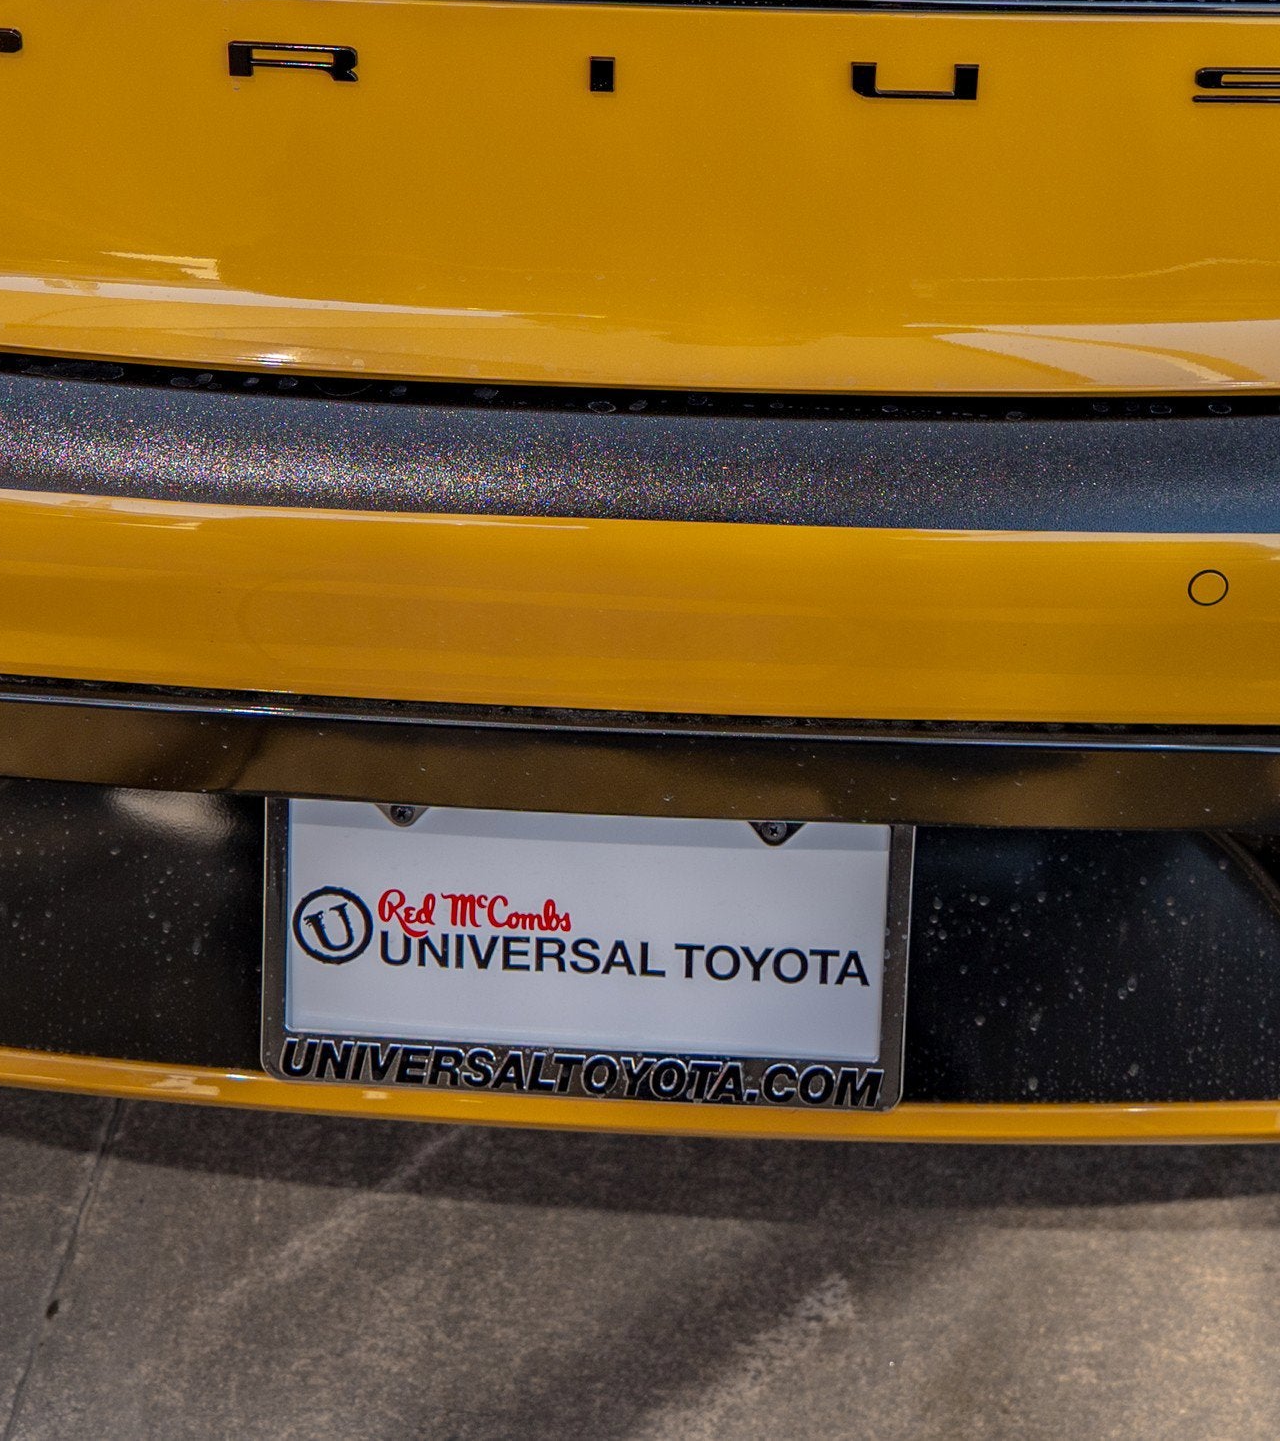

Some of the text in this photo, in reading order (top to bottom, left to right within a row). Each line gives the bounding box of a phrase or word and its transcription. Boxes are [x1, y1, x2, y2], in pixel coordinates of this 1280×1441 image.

[378, 888, 572, 938] Red McCombs
[379, 930, 870, 986] UNIVERSAL TOYOTA
[280, 1038, 884, 1108] UNIVERSALTOYOTA.COM
